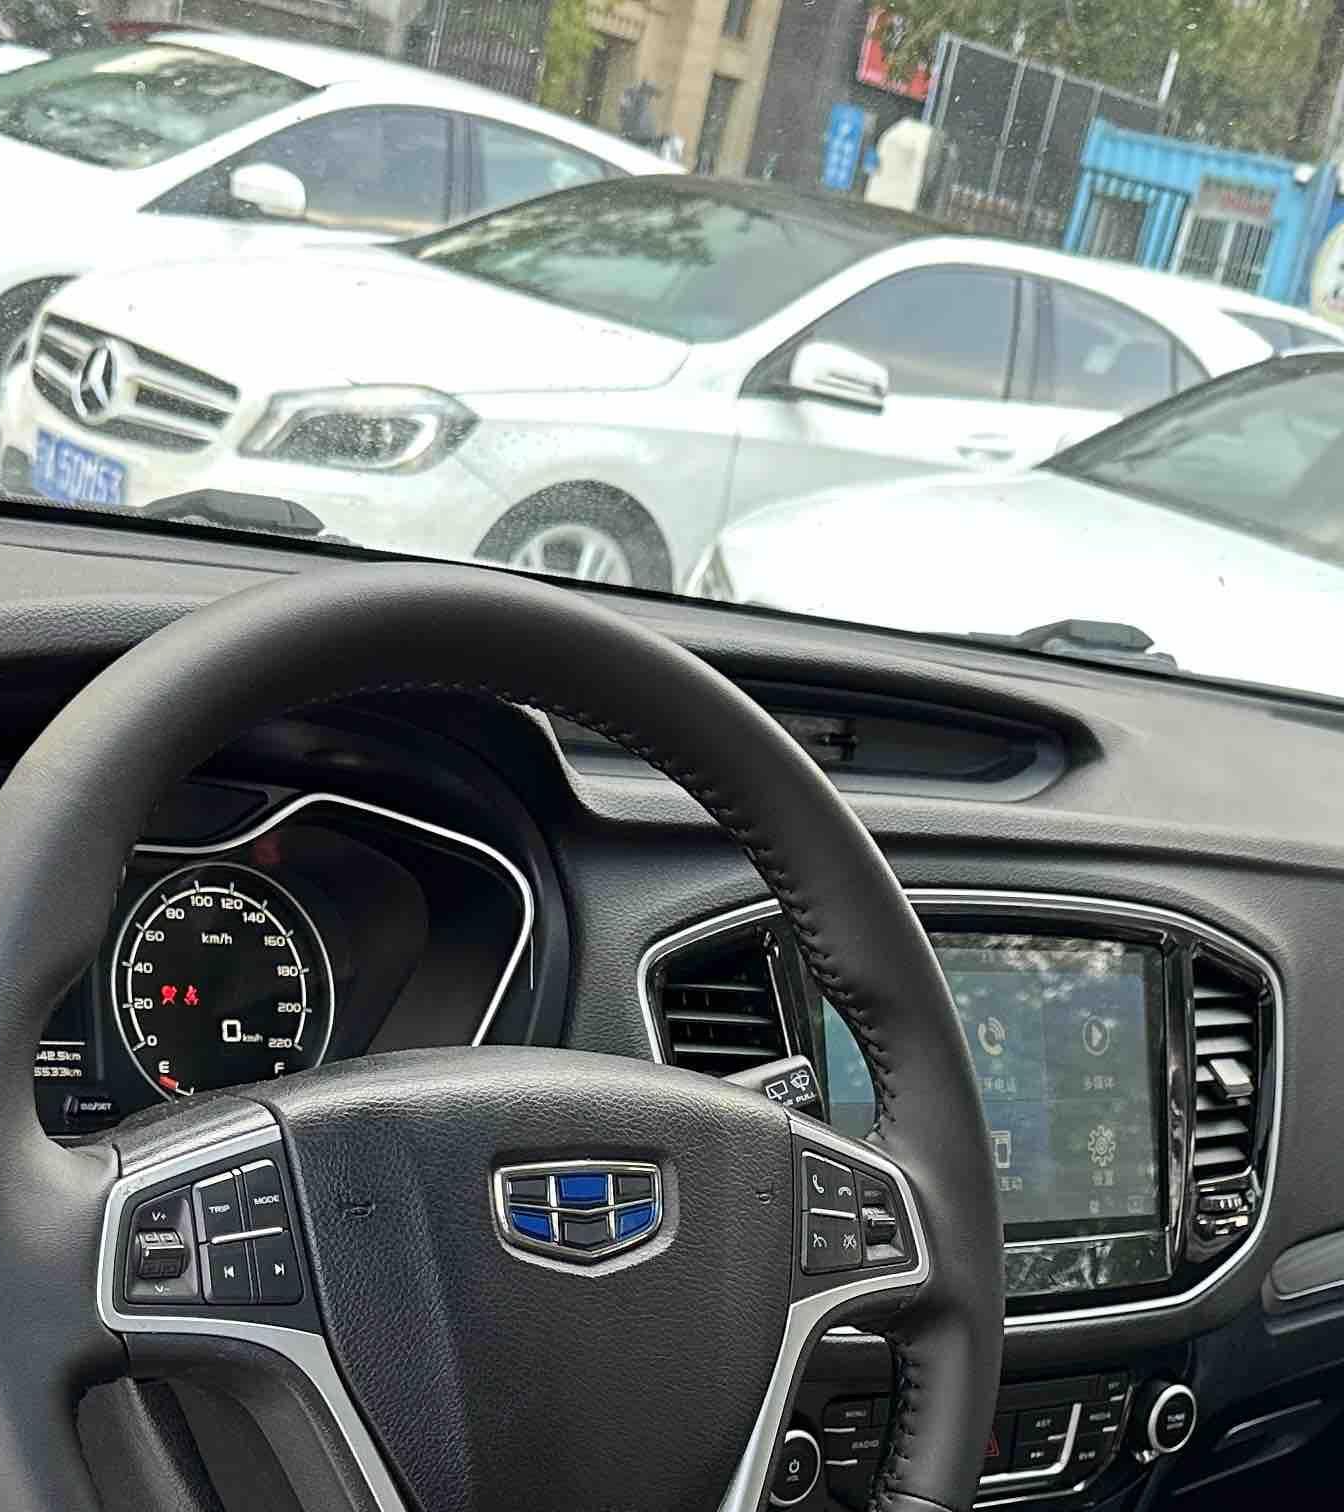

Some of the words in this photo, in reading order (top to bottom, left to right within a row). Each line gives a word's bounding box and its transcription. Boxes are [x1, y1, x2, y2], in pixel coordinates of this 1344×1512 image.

[191, 896, 213, 907] 100
[221, 898, 244, 910] 120
[165, 908, 186, 920] 80
[242, 912, 266, 924] 140
[145, 931, 165, 942] 60
[201, 932, 233, 945] km/h
[264, 935, 287, 947] 160
[134, 963, 154, 974] 40
[277, 966, 299, 977] 180
[134, 999, 154, 1010] 20
[277, 1002, 302, 1014] 200
[221, 1019, 242, 1043] 0
[146, 1035, 158, 1047] 0
[268, 1038, 293, 1049] 220
[158, 1060, 170, 1074] E
[274, 1062, 286, 1074] F
